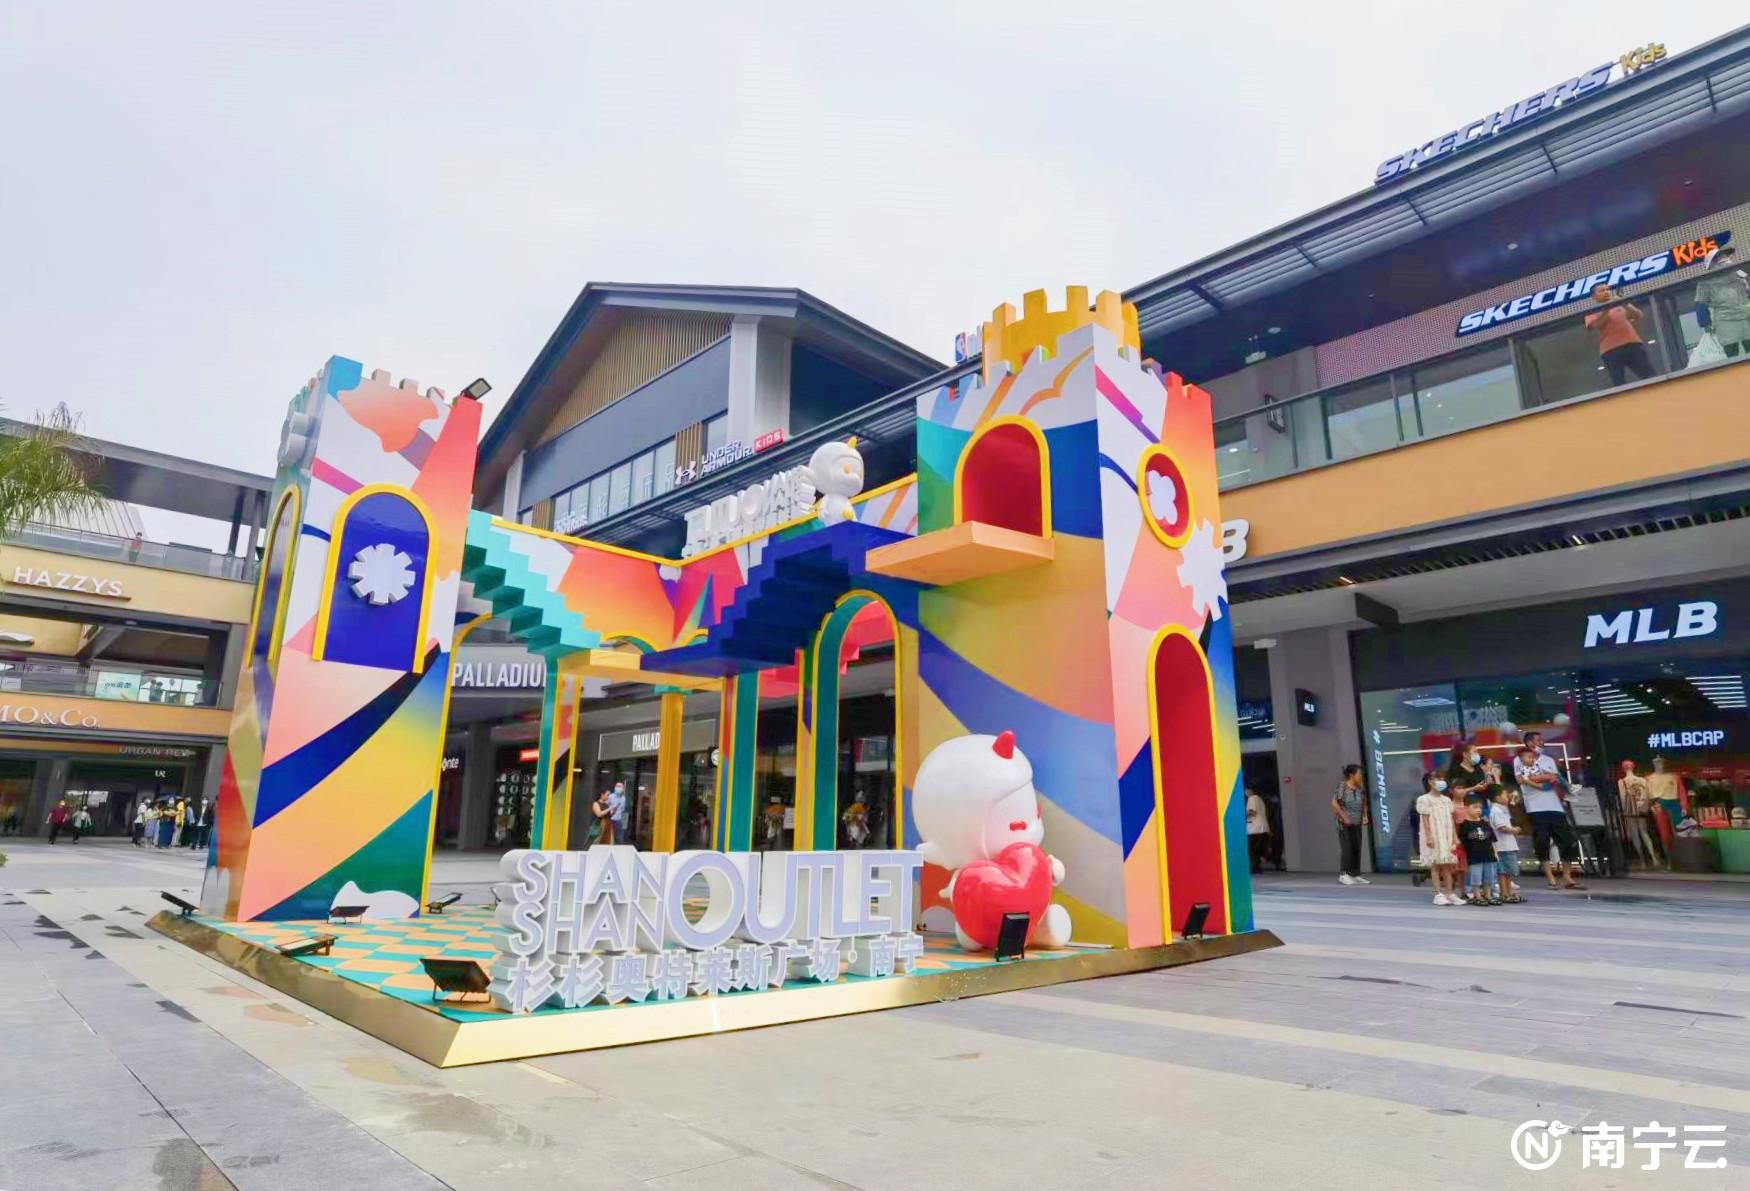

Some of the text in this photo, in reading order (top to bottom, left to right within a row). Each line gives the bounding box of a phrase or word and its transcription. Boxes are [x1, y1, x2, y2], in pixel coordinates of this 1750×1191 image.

[1374, 42, 1667, 184] SKECHERS Kids
[1460, 250, 1670, 334] SKECHERS
[702, 440, 742, 465] UNDER
[755, 431, 782, 449] KIDS
[13, 567, 123, 596] HAZZYS
[1584, 601, 1718, 648] MLB
[451, 662, 546, 688] PALLADIU
[1648, 730, 1725, 748] #MLBCAP
[667, 851, 925, 951] OUTLET
